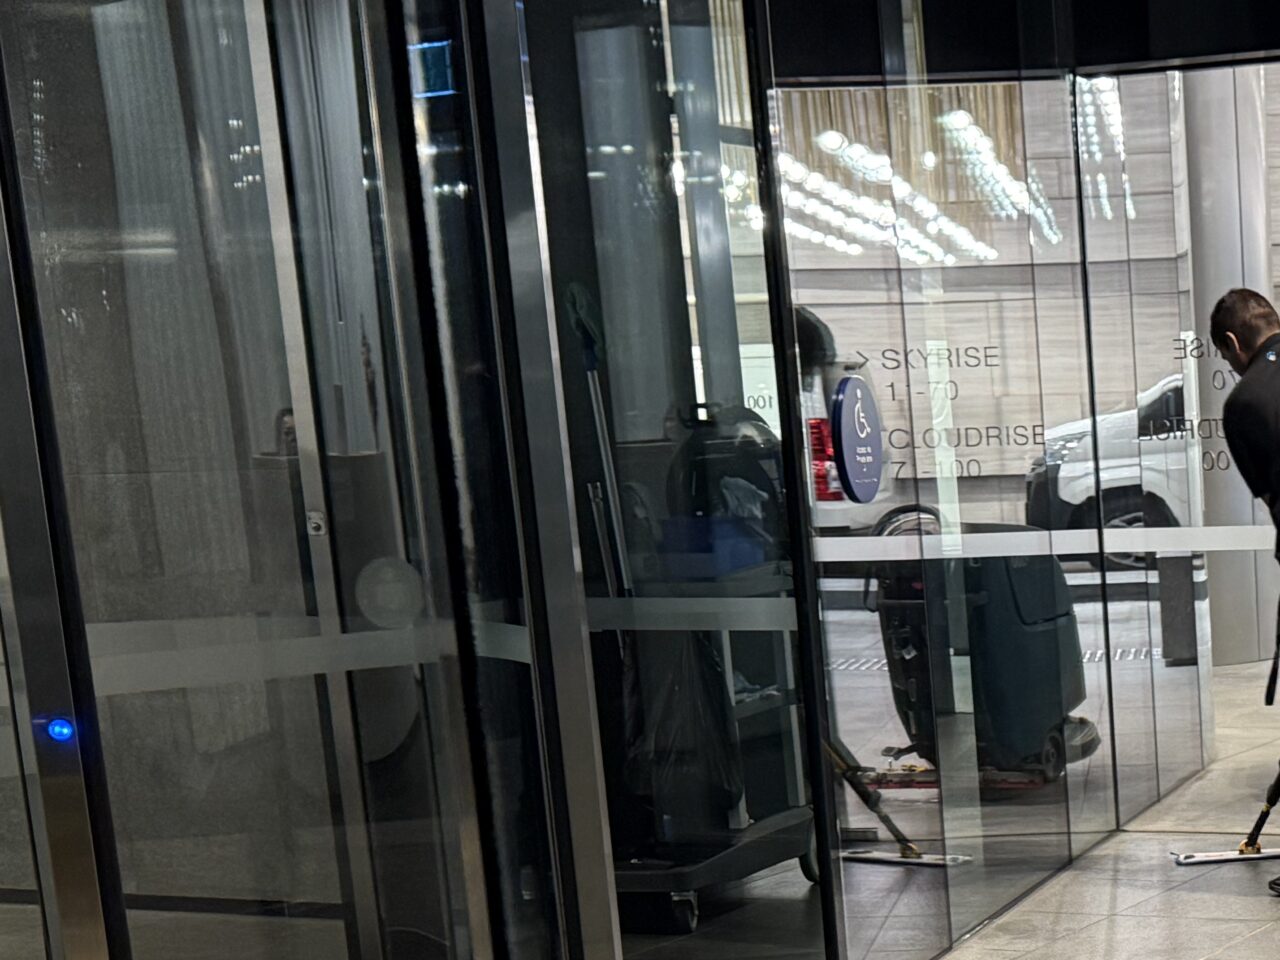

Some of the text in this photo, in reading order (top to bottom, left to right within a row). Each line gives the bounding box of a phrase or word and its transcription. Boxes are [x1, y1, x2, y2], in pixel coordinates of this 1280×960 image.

[881, 346, 1000, 371] SKYRISE
[927, 380, 959, 401] 70
[888, 425, 1045, 450] CLOUDRISE
